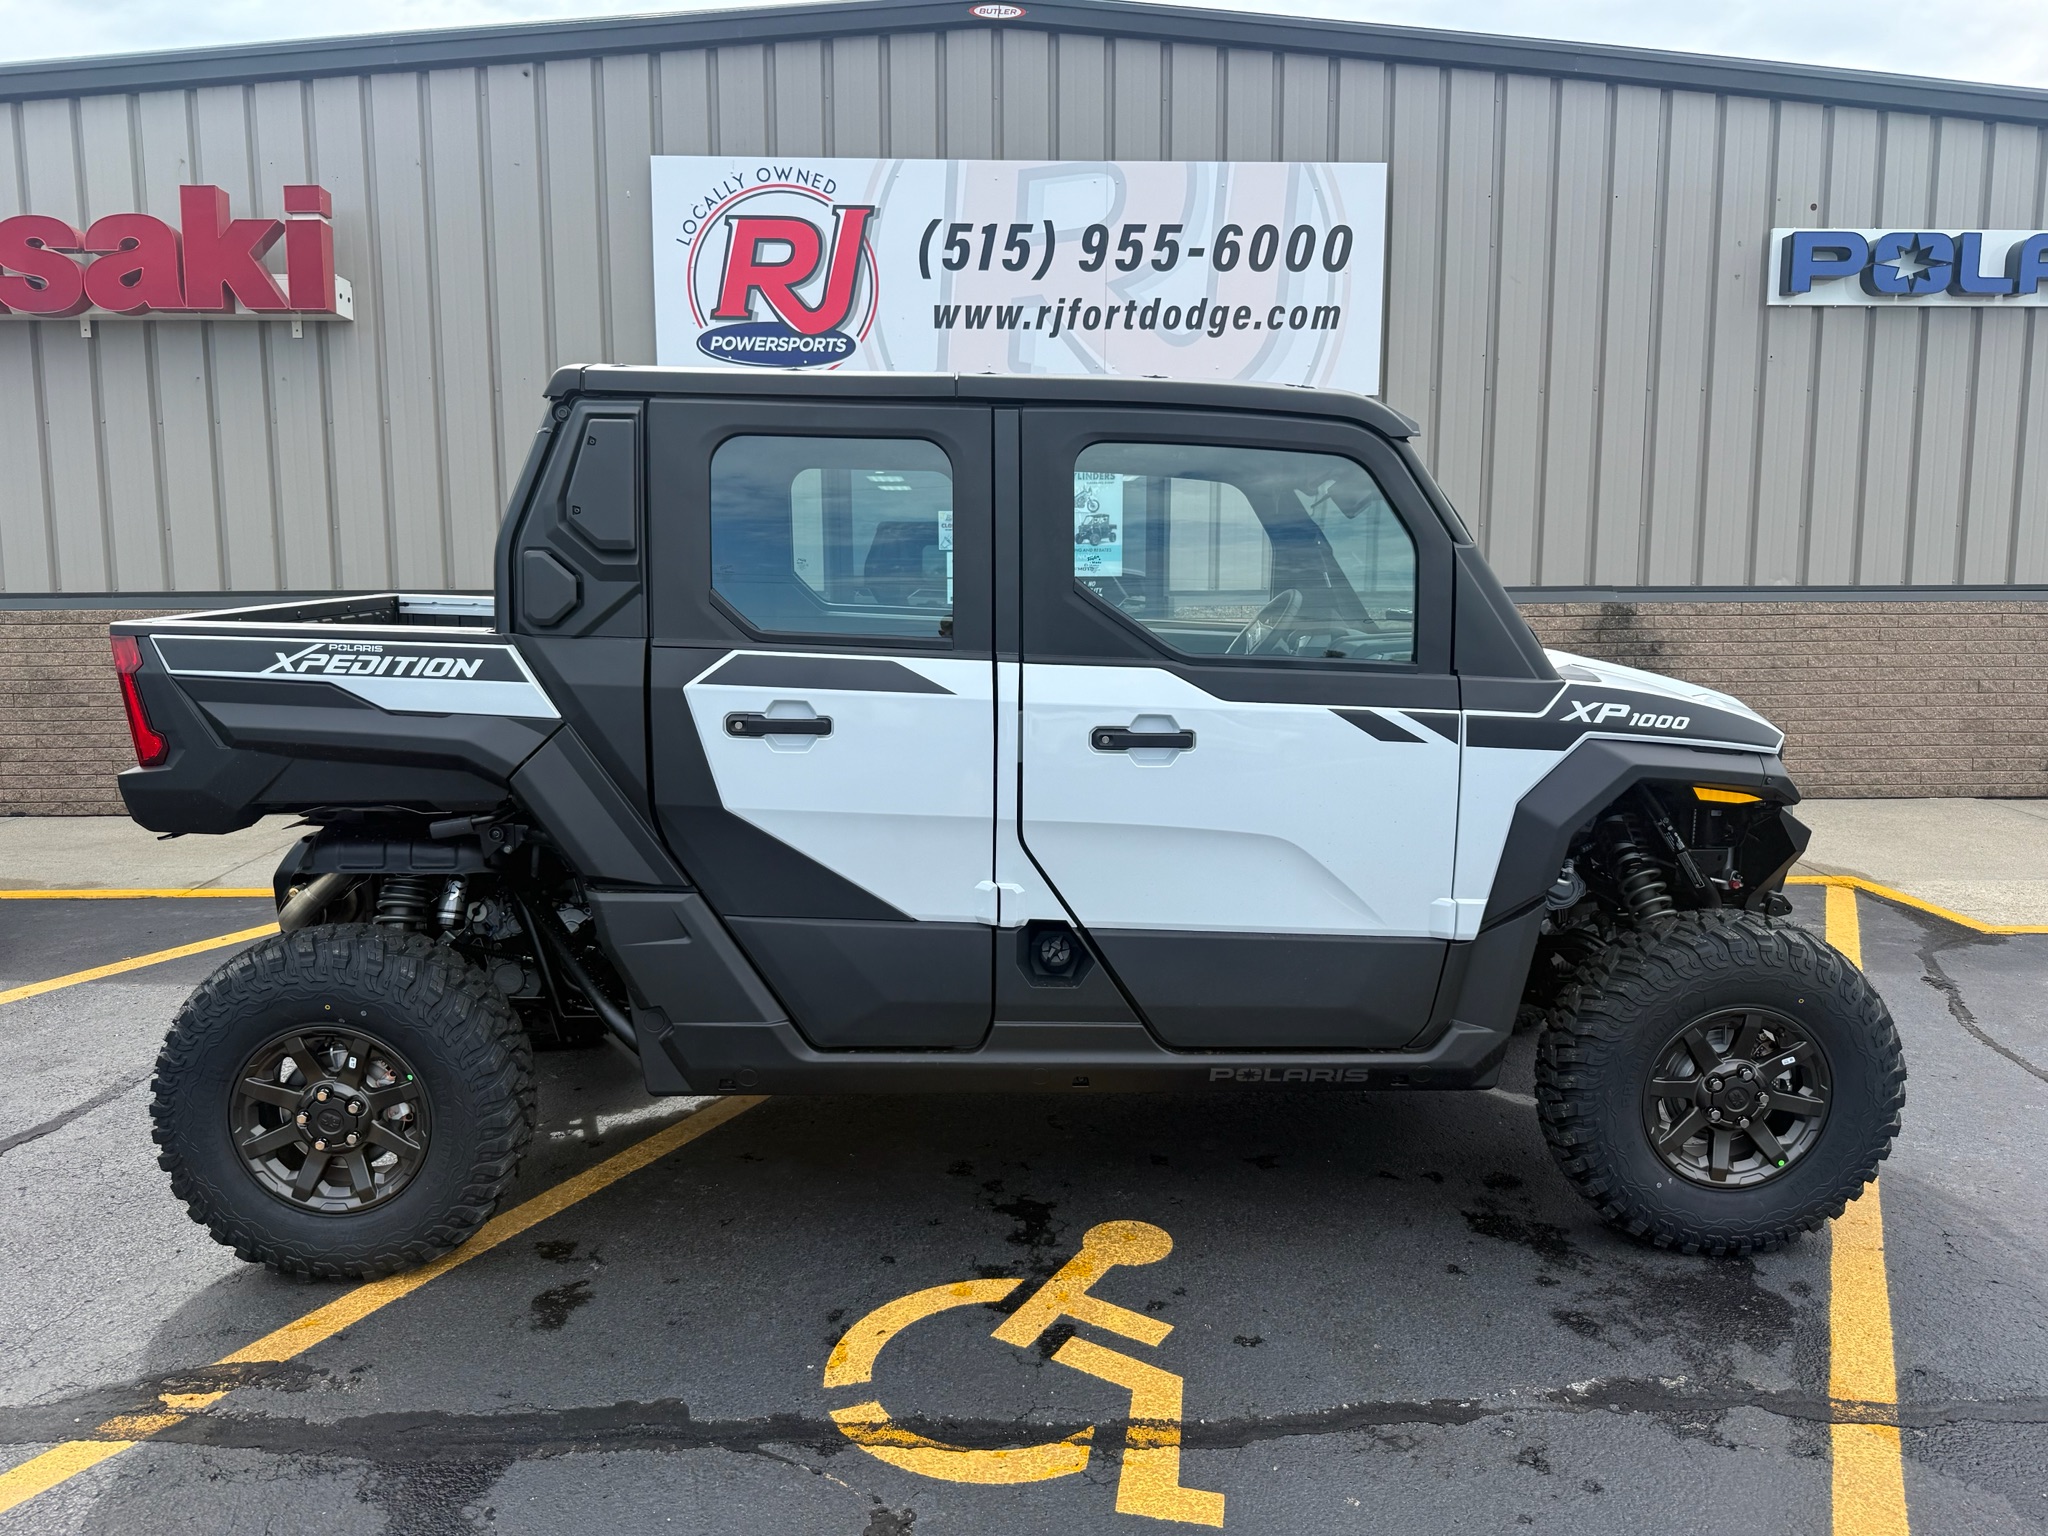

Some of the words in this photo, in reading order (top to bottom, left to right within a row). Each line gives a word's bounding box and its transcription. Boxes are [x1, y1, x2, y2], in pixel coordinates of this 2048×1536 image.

[676, 172, 745, 247] LOCALLY
[756, 166, 837, 195] OWNED
[918, 218, 1056, 281] (515)
[1077, 223, 1354, 273] 955-6000
[709, 204, 877, 337] RJ
[932, 297, 1342, 338] www.rjfortdodge.com
[709, 336, 848, 353] POWERSPORTS
[260, 643, 484, 678] XPEDITION
[328, 643, 384, 653] POLARIS
[1558, 700, 1631, 724] XP
[1628, 713, 1691, 730] 1000
[1208, 1067, 1370, 1083] POLARIS
